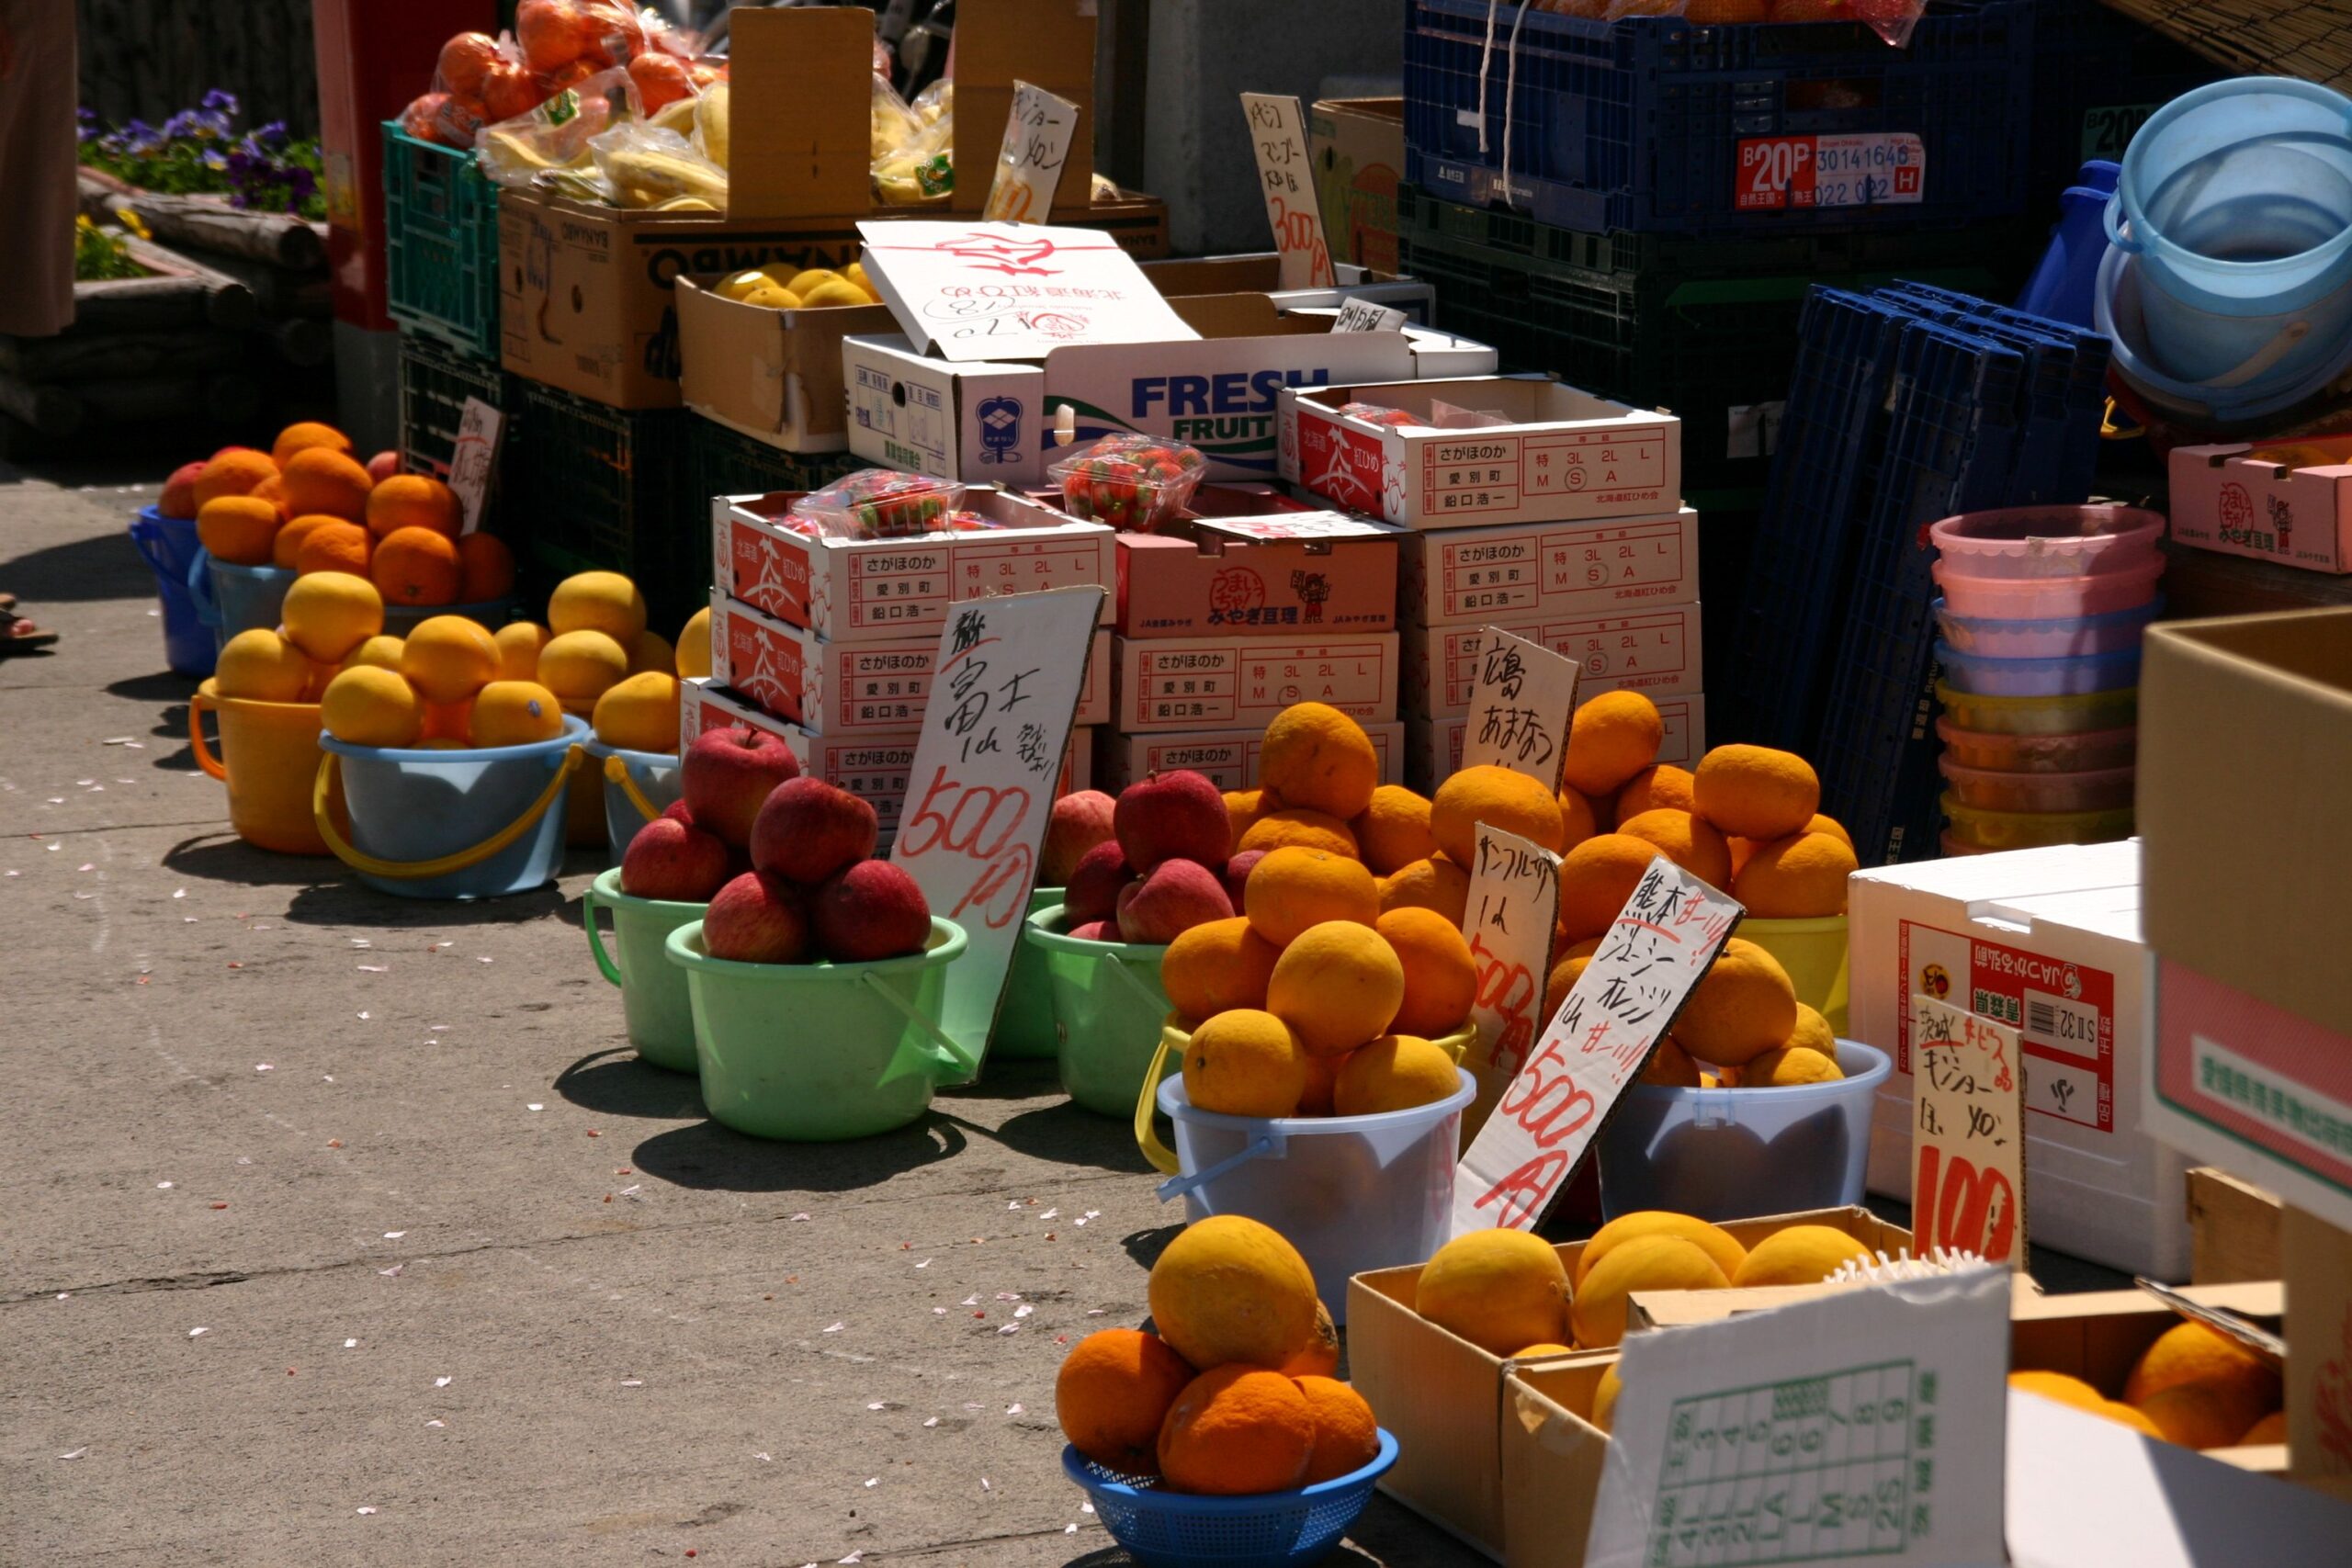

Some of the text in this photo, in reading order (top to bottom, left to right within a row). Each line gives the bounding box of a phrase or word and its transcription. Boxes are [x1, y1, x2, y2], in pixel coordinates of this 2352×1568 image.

[1899, 172, 1914, 190] H
[1271, 197, 1314, 254] 300
[648, 247, 862, 289] NAMBO
[1172, 416, 1272, 442] FRUIT
[1353, 446, 1379, 473] 紅ひめ
[1440, 445, 1507, 460] さがほのか
[1536, 448, 1649, 468] 特 3L 2L L
[1449, 469, 1502, 485] 愛別町
[1537, 470, 1617, 488] M S A
[1460, 545, 1524, 560] さがほのか
[1554, 543, 1666, 565] 特 3L 2L L
[866, 557, 936, 573] さがほのか
[966, 559, 1084, 579] 特 3L 2L L
[1470, 569, 1520, 585] 愛別町
[1555, 566, 1634, 585] M S A
[876, 580, 932, 596] 愛別町
[969, 582, 1052, 598] M S A
[1556, 632, 1668, 654] 特 3L 2L L
[858, 655, 930, 671] さがほのか
[1157, 654, 1225, 669] さがほのか
[1482, 640, 1527, 699] 広島
[1591, 656, 1637, 670] S A
[1252, 662, 1366, 680] 特 3L 2L L
[865, 681, 921, 695] 愛別町
[1163, 680, 1217, 694] 愛別町
[1252, 685, 1333, 698] M S A
[1665, 722, 1674, 735] L
[843, 749, 914, 765] さがほのか
[1165, 750, 1231, 764] さがほのか
[850, 776, 905, 791] 愛別町
[899, 764, 1030, 861] 500
[1623, 867, 1686, 928] 熊本
[1974, 944, 2060, 987] JAつがる弘前
[1973, 987, 2021, 1022] 青森県
[2098, 1014, 2112, 1055] 玉数
[1500, 1039, 1595, 1149] 500
[2098, 1081, 2111, 1122] 品種
[1914, 1145, 2016, 1261] 100
